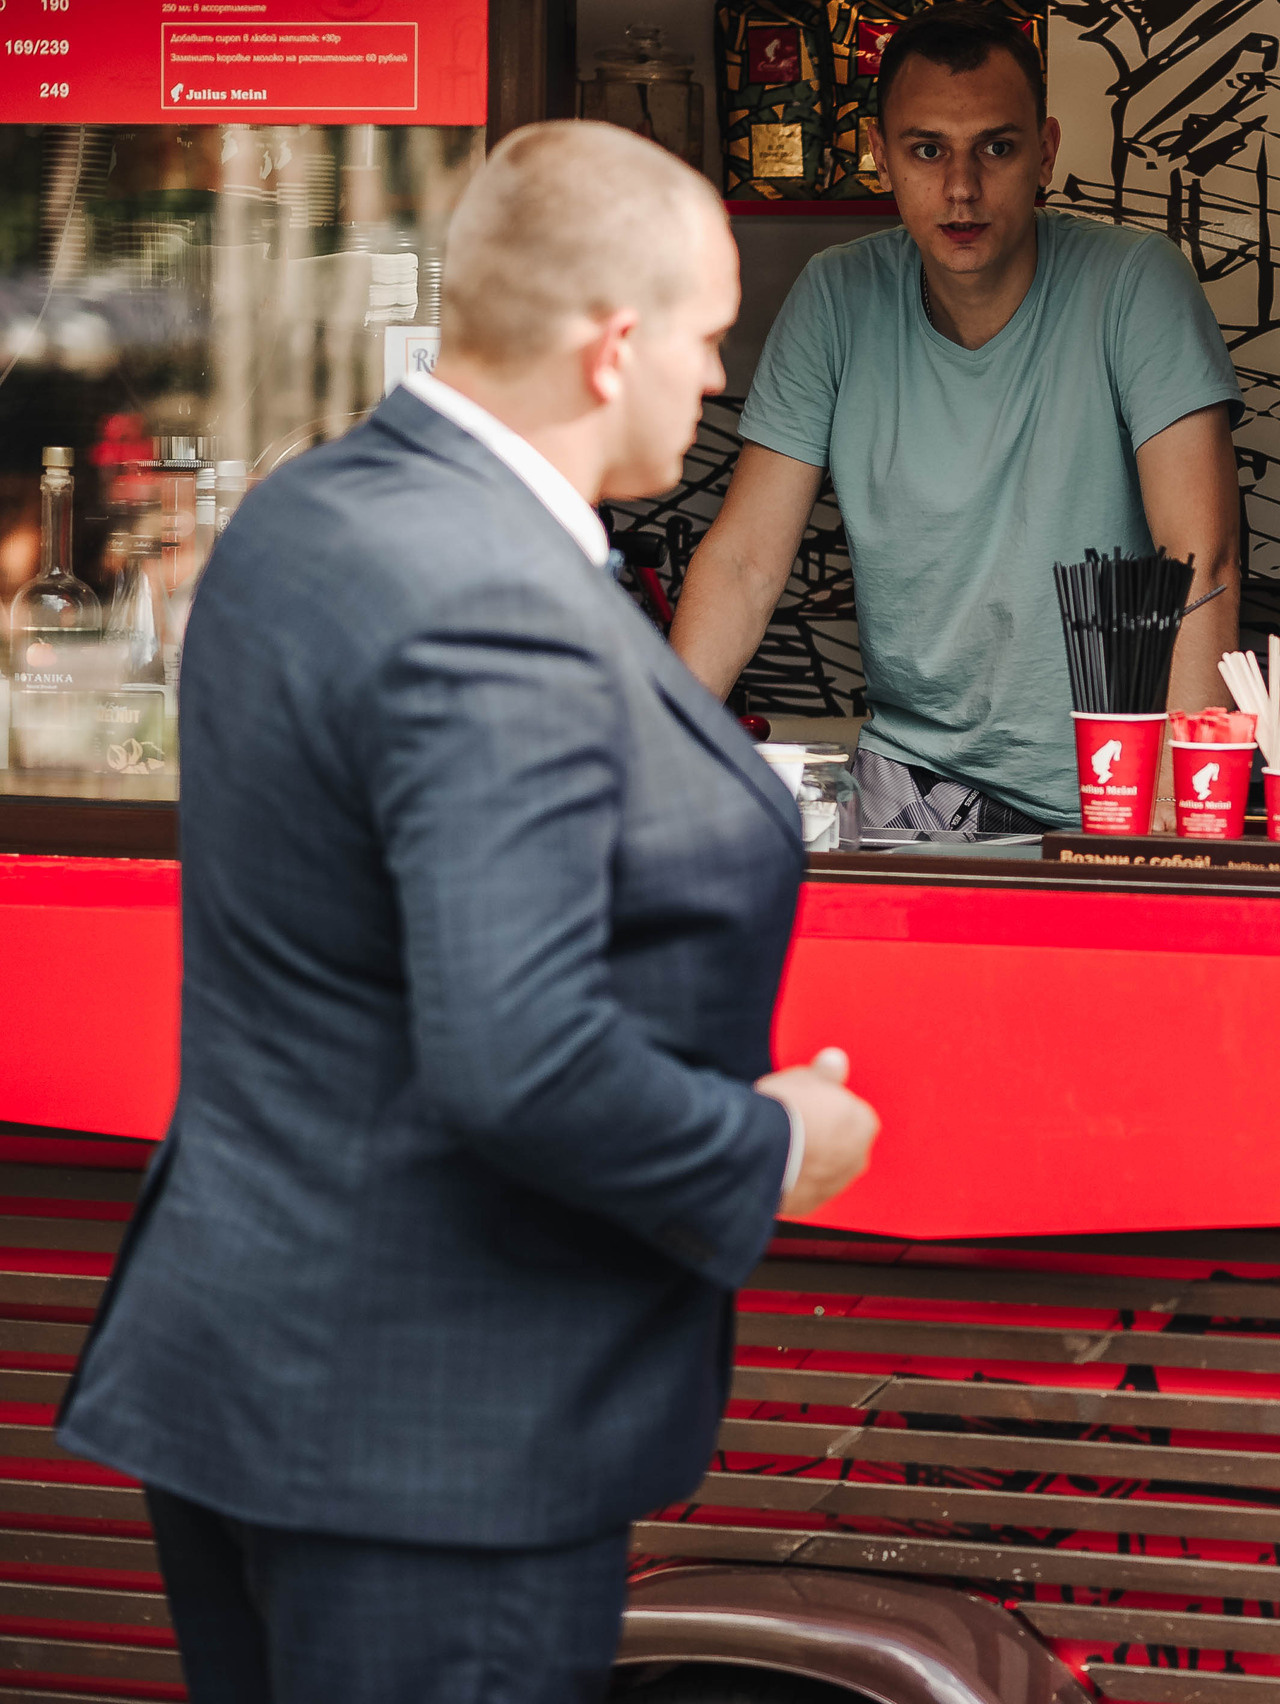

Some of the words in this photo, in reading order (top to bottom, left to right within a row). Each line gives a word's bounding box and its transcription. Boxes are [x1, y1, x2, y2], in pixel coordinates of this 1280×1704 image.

[41, 0, 69, 11] 190
[170, 33, 214, 43] Добавить
[215, 35, 241, 44] сироп
[250, 33, 278, 43] любой
[5, 39, 70, 55] 169/239
[170, 52, 215, 62] Заменить
[252, 53, 285, 62] молоко
[39, 82, 70, 98] 249
[185, 89, 228, 101] Julius
[230, 89, 268, 100] Meinl
[14, 672, 73, 683] BOTANIKA
[1106, 785, 1138, 796] Meinl
